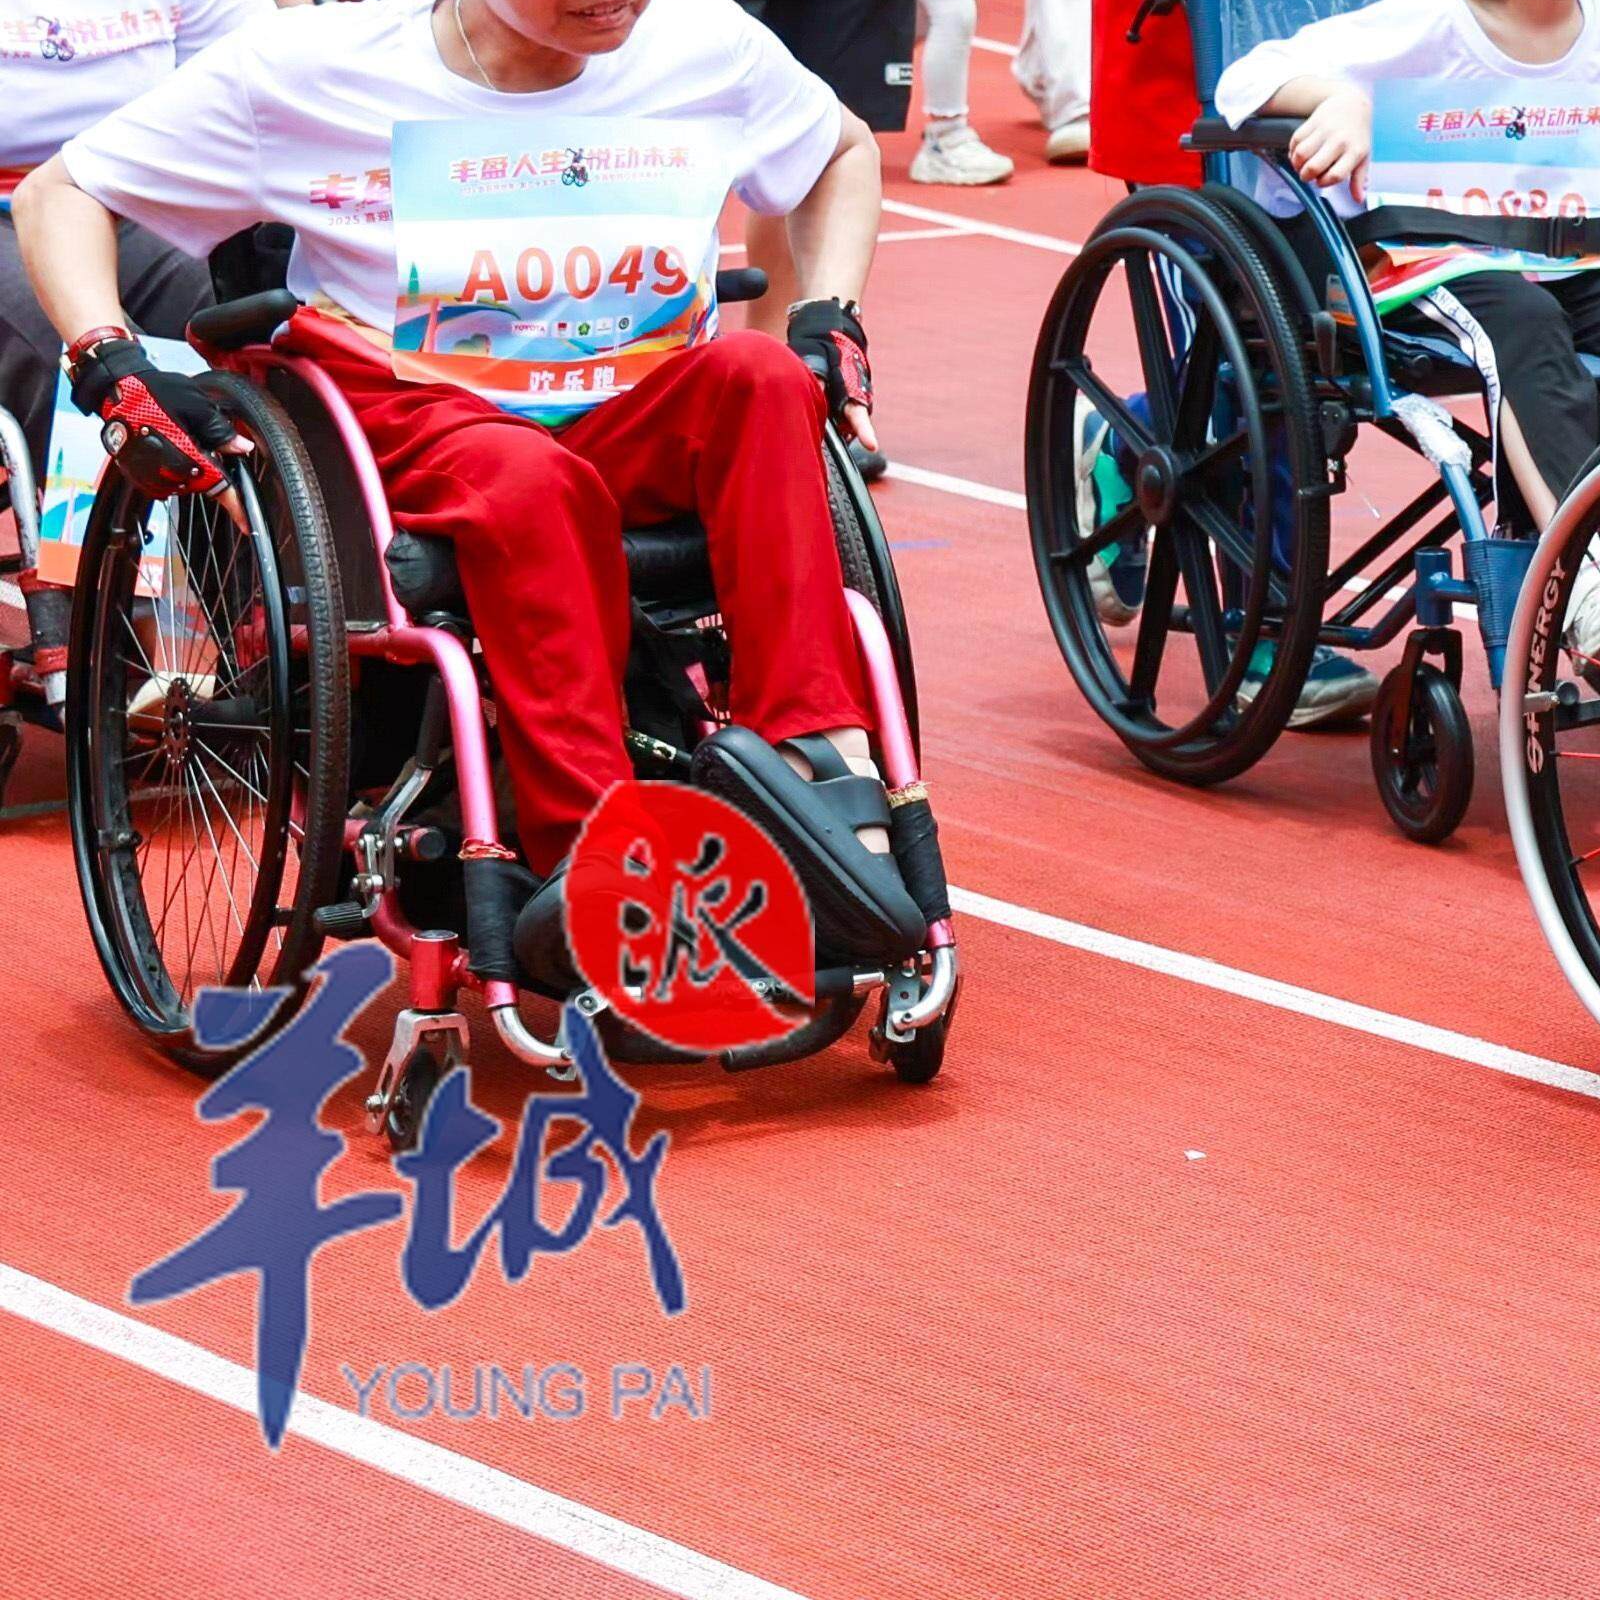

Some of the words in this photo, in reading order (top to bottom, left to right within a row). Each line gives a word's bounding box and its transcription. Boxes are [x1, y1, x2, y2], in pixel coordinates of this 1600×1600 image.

[1419, 108, 1511, 131] 丰盈人生
[450, 151, 567, 183] 丰盈人生
[587, 147, 689, 172] 悦动未来
[460, 245, 690, 303] A0049
[529, 366, 616, 392] 欢乐跑
[1525, 556, 1566, 774] SPNERGY
